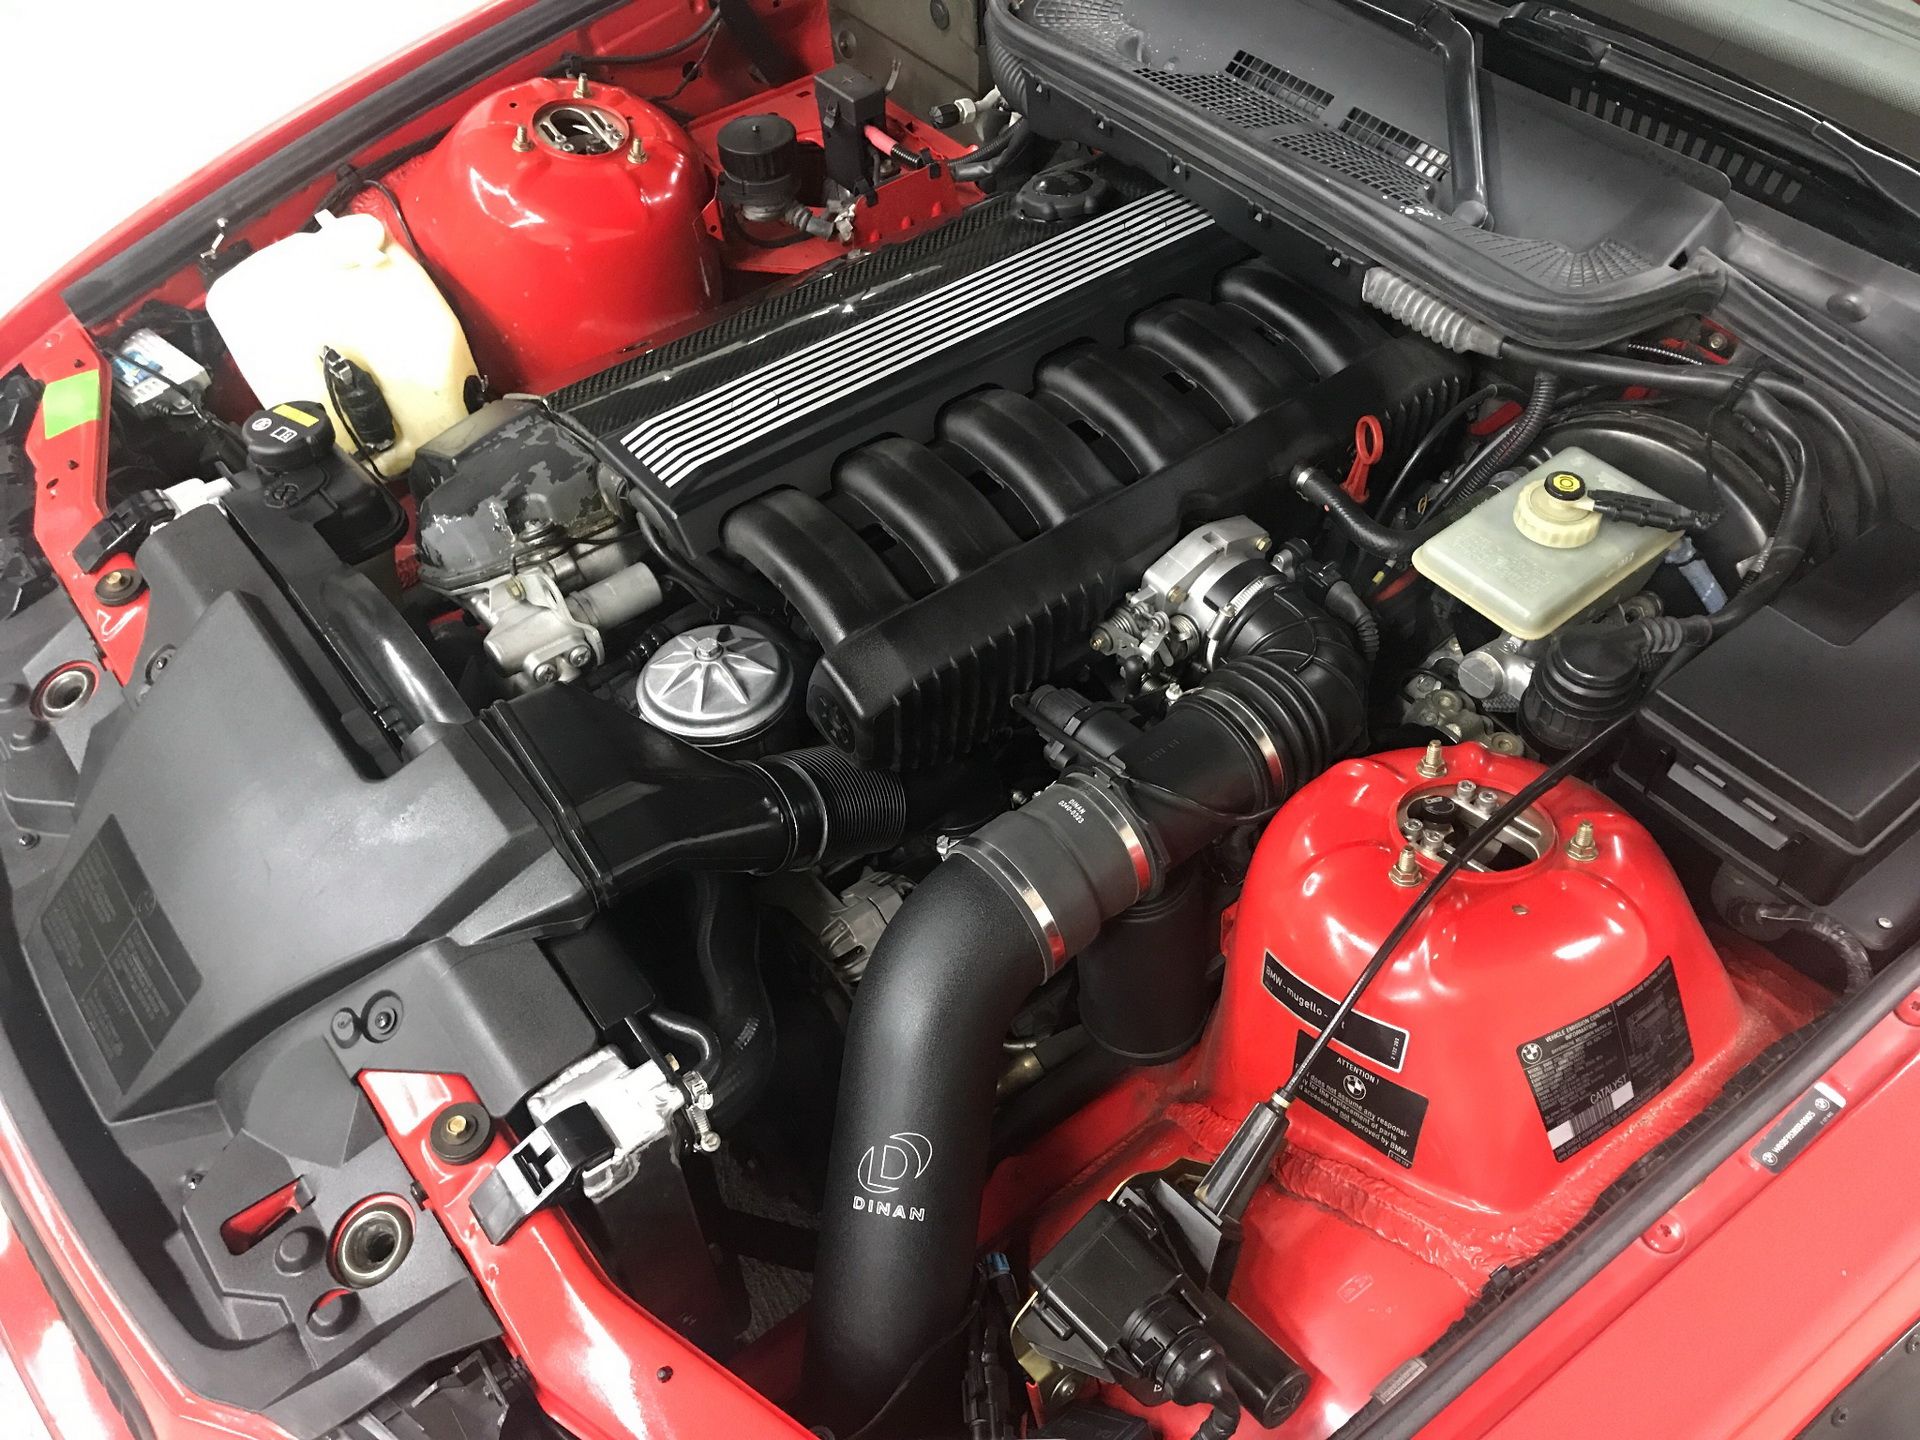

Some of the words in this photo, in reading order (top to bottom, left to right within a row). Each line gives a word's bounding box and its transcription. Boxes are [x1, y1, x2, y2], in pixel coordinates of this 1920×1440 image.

[1068, 799, 1086, 815] DINAN
[1265, 965, 1283, 987] BMW
[1286, 987, 1323, 1016] mugello
[1336, 1057, 1376, 1083] ATTENTION
[1590, 1073, 1627, 1104] CATALYST
[1303, 1087, 1339, 1114] accessories
[1351, 1118, 1380, 1140] approved
[1380, 1136, 1389, 1147] by
[1309, 1081, 1318, 1091] for
[1319, 1088, 1330, 1099] the
[1330, 1096, 1370, 1125] replacement
[1371, 1122, 1379, 1130] of
[1379, 1127, 1397, 1141] parts
[1310, 1074, 1326, 1088] does
[1325, 1084, 1337, 1096] not
[1337, 1091, 1363, 1111] assume
[1363, 1108, 1377, 1120] any
[1377, 1116, 1410, 1137] responsi-
[852, 1195, 925, 1222] DINAN
